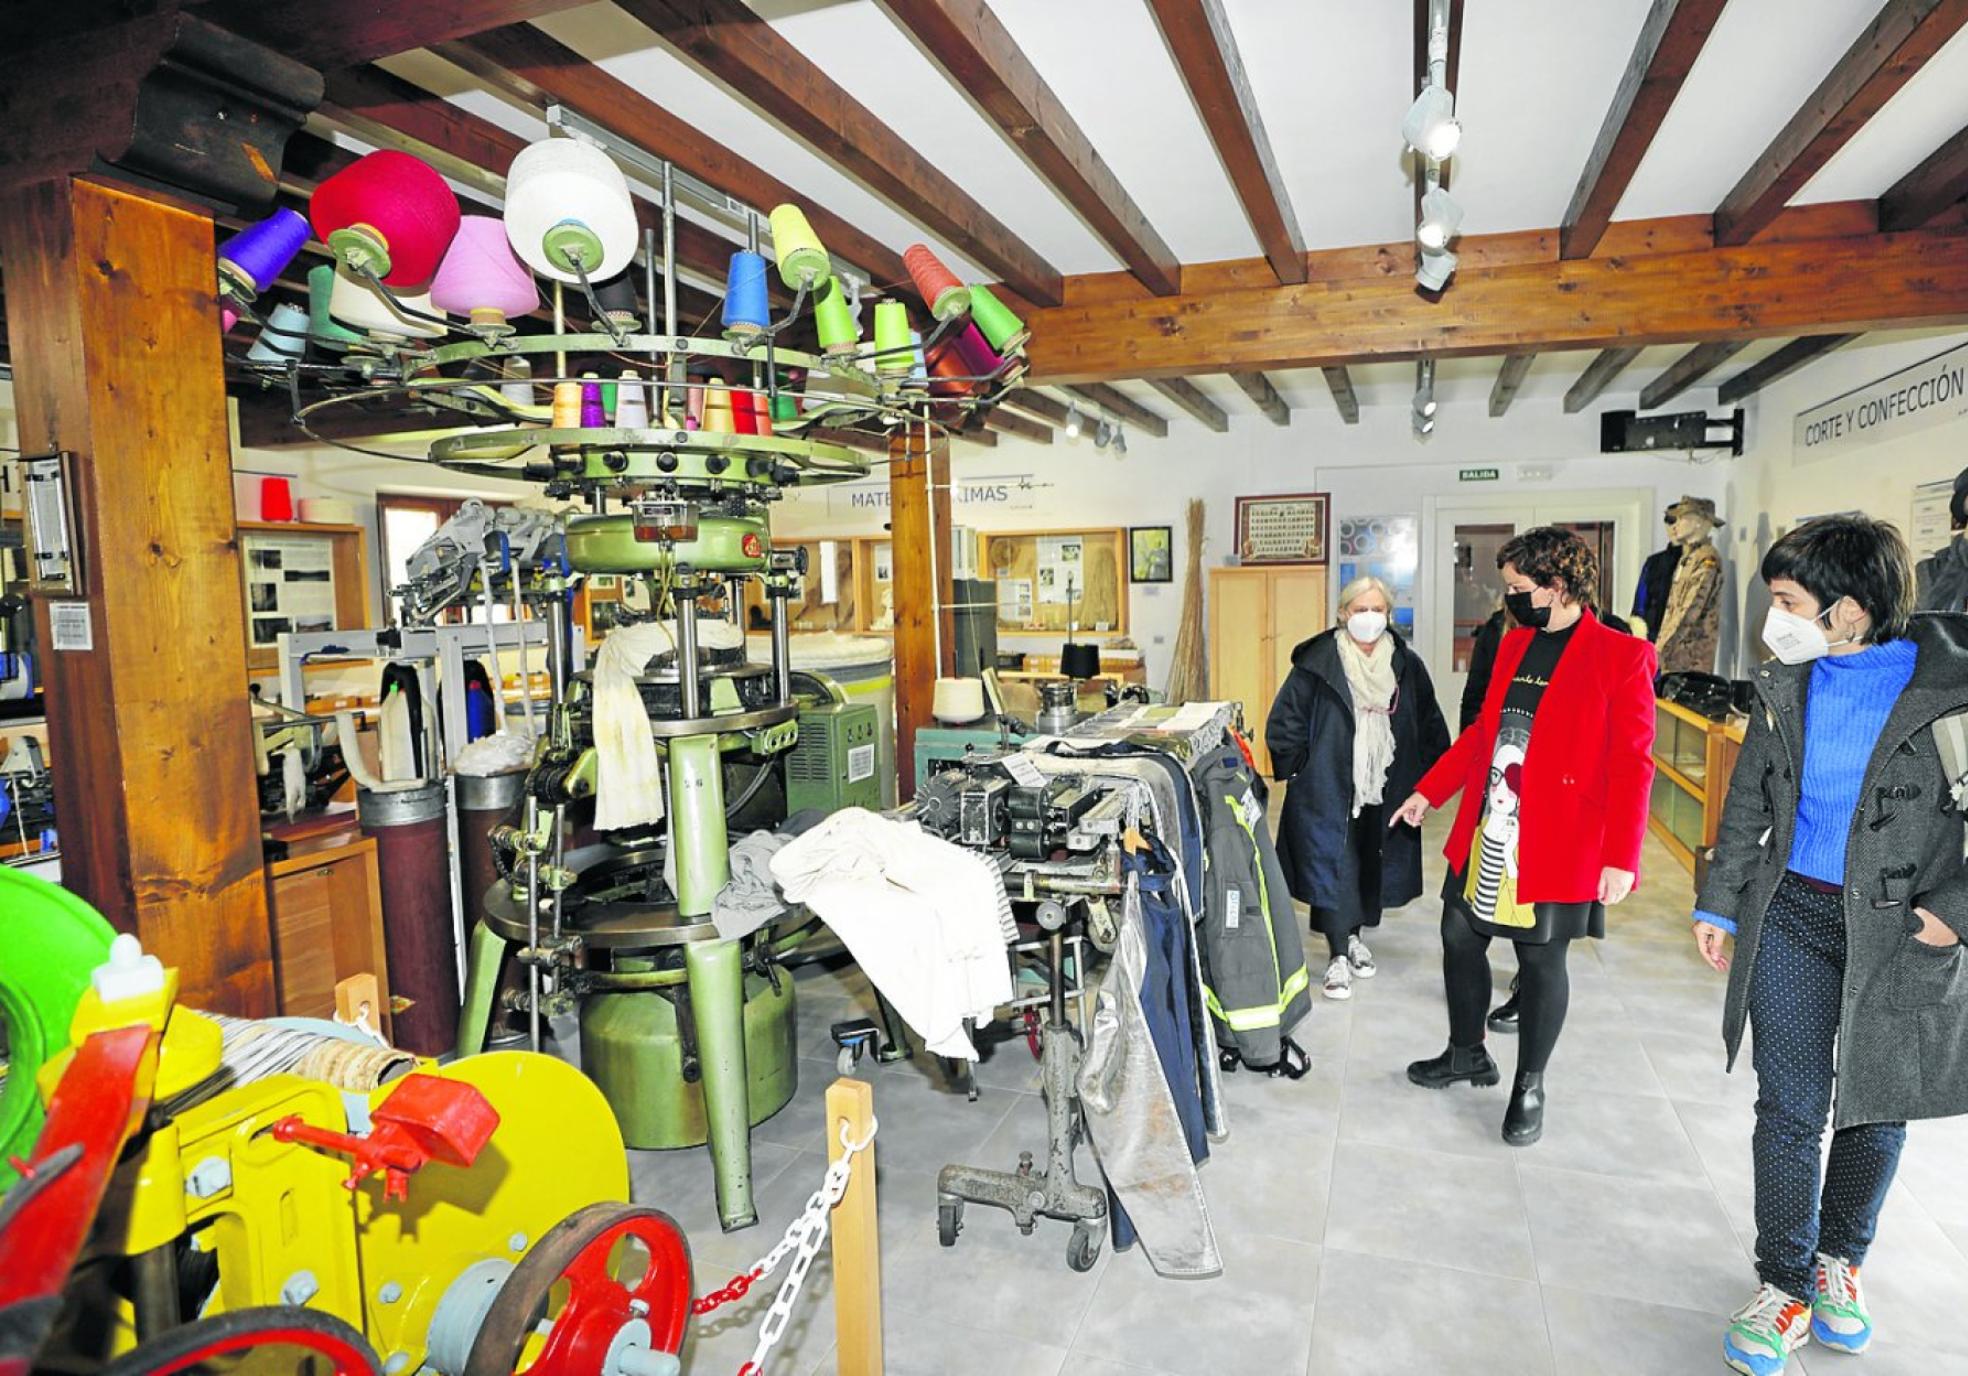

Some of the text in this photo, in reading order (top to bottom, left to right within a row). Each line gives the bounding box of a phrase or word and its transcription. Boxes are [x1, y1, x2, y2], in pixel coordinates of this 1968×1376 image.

[1805, 363, 1965, 447] CORTE Y CONFECCIÓN
[1462, 470, 1497, 479] SALIDA
